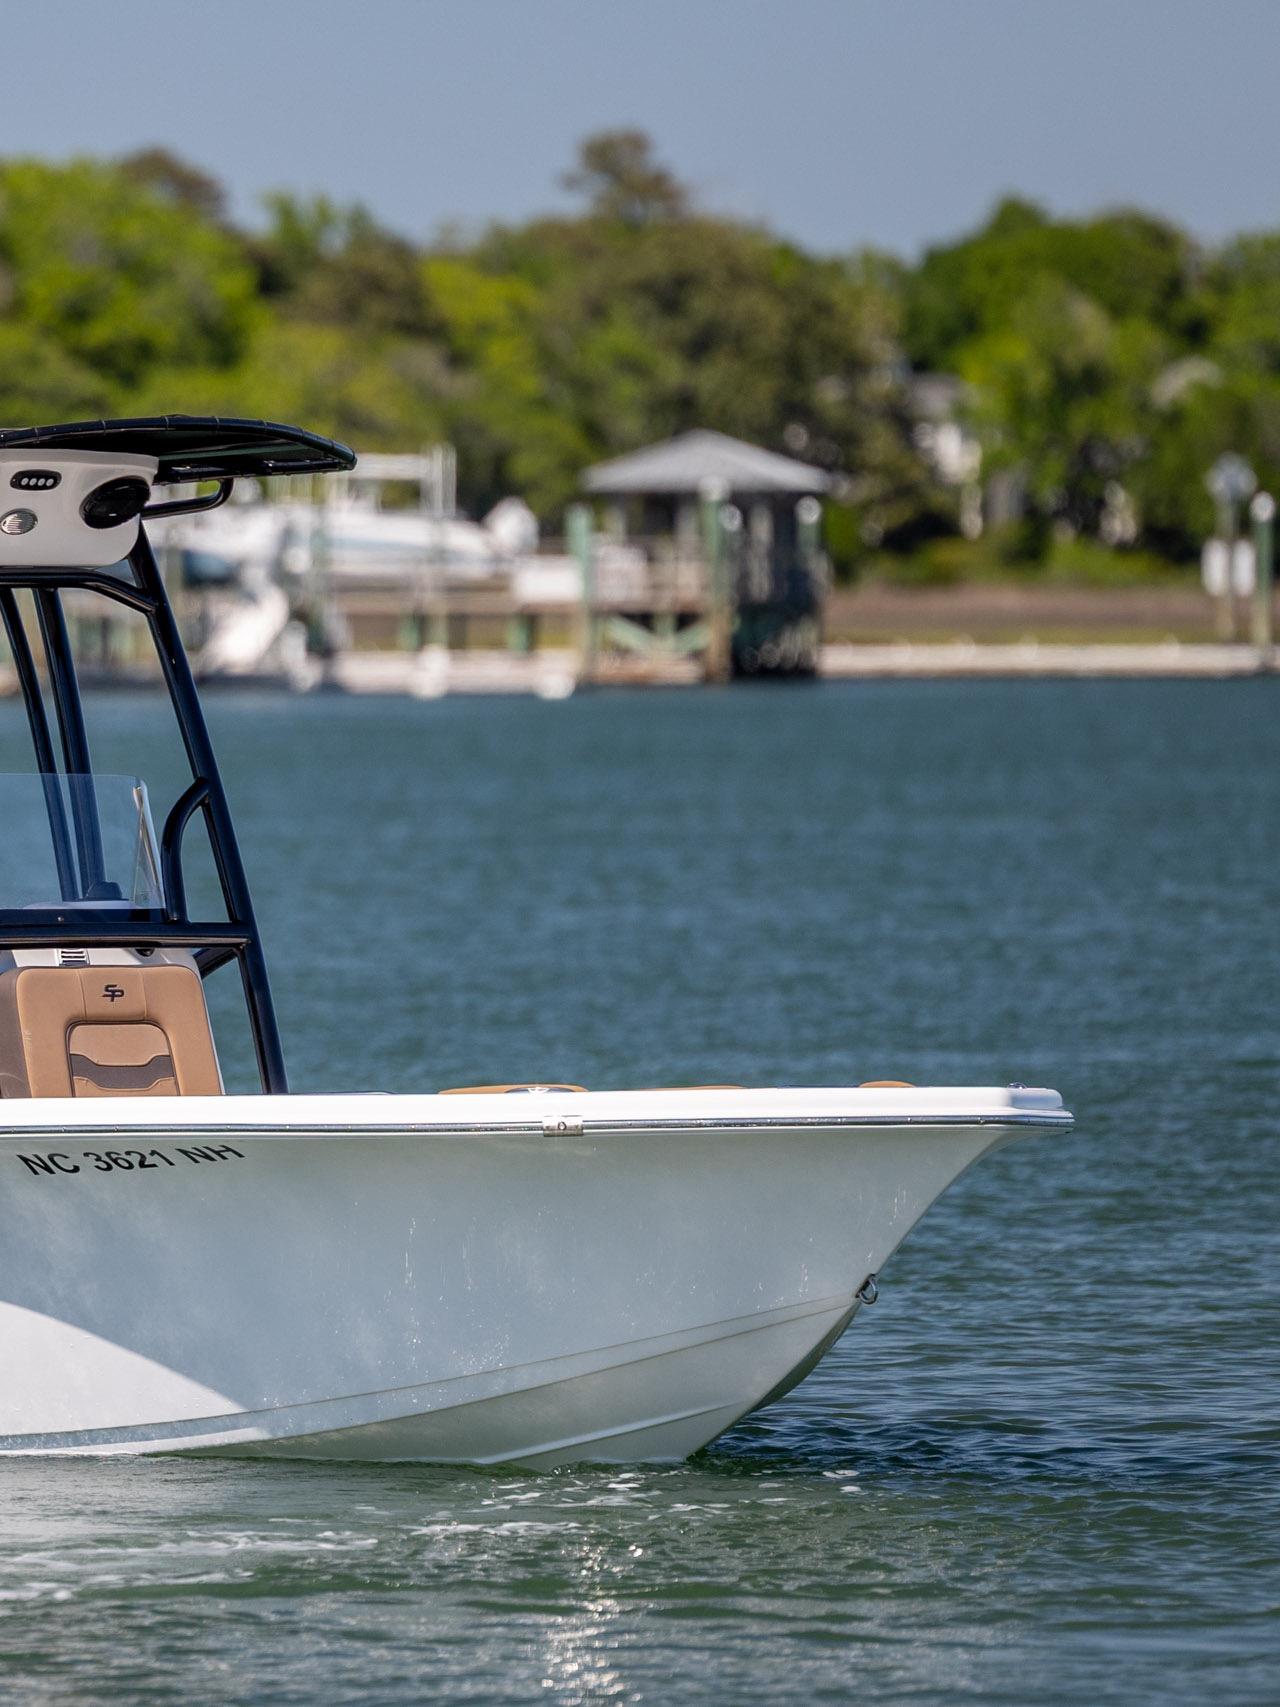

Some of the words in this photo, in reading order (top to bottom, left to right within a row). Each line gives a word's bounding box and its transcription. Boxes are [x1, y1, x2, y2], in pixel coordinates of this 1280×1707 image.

[16, 1152, 81, 1176] NC
[83, 1149, 176, 1172] 3621
[175, 1144, 246, 1164] NH
